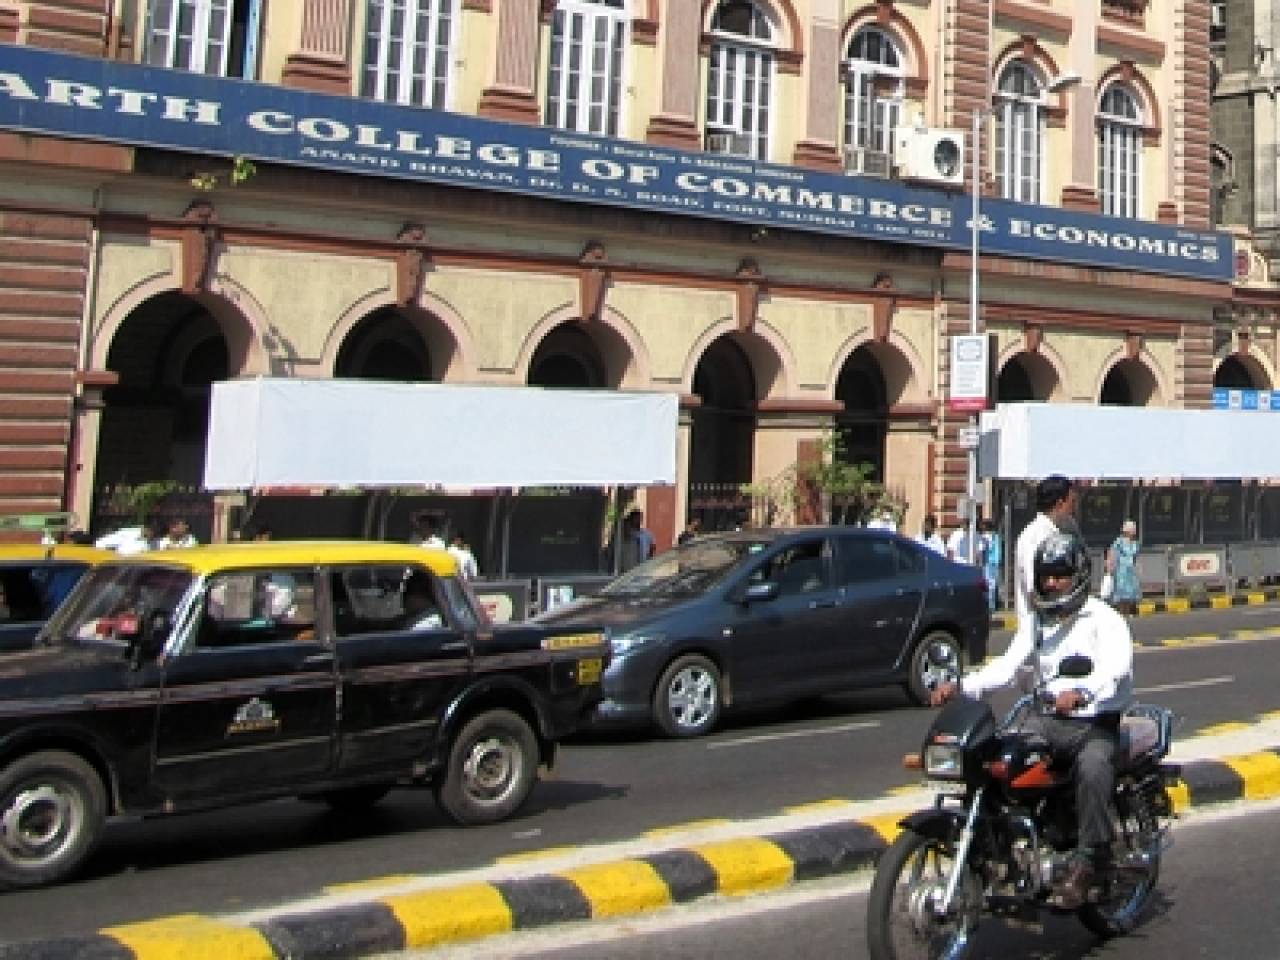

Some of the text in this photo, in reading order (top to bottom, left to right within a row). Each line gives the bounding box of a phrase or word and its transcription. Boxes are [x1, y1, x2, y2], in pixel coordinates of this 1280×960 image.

[247, 111, 560, 173] COLLEGE
[582, 158, 660, 186] OF
[676, 171, 953, 227] COMMERCE
[1010, 219, 1220, 262] ECONOMICS
[300, 145, 400, 168] ANAND
